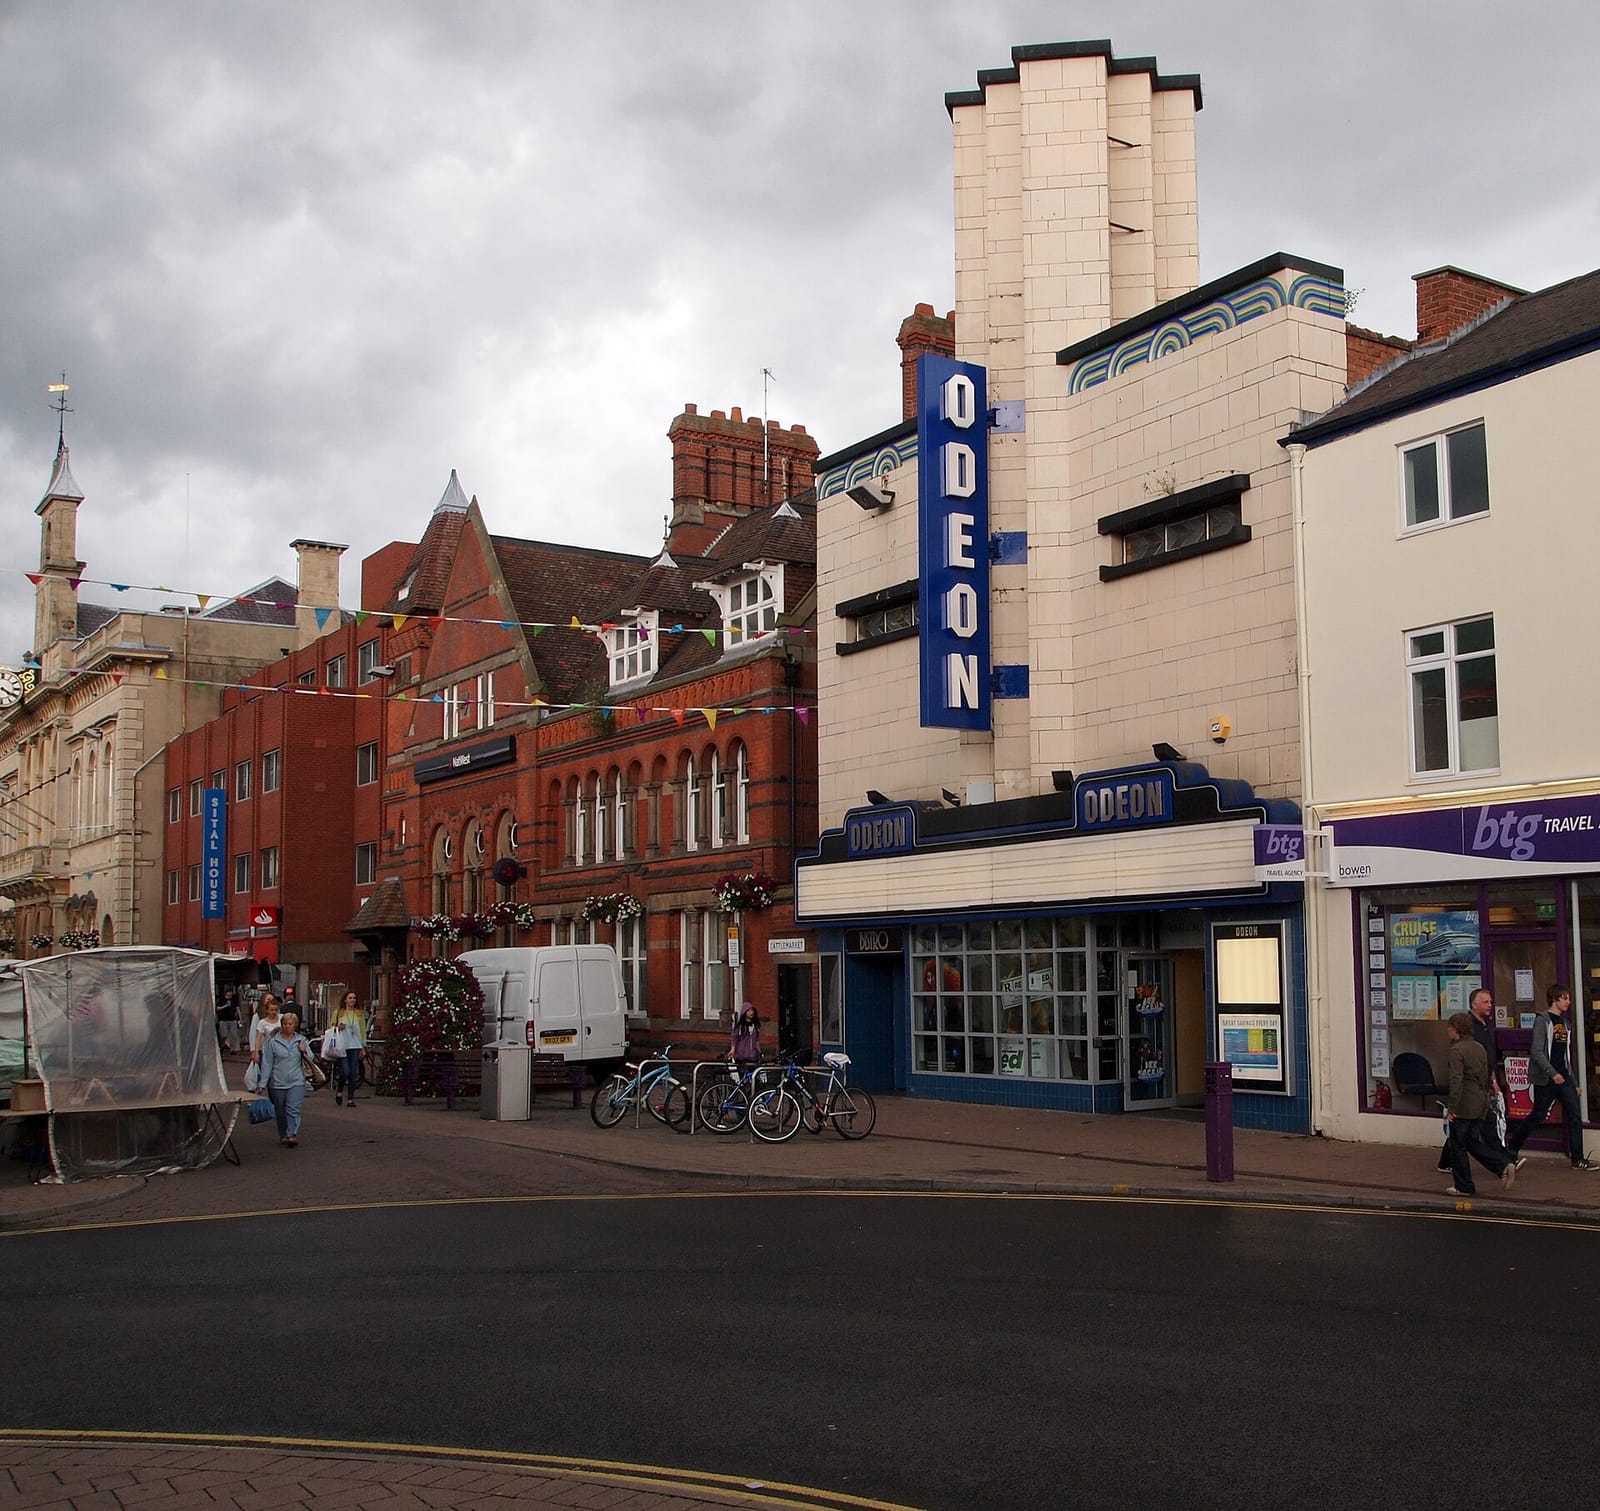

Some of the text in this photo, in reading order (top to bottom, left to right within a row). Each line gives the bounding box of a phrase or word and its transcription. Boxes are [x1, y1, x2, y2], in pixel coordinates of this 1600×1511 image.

[940, 374, 978, 709] ODEON
[1084, 780, 1163, 823] ODEON
[849, 817, 906, 851] ODEON
[1472, 805, 1595, 861] btg TRAVEL
[209, 797, 219, 910] SITAL HOUSE
[1267, 830, 1301, 861] btg
[1338, 864, 1371, 876] bowen
[1235, 926, 1258, 937] ODEON
[1393, 921, 1437, 937] CRUISE
[1394, 936, 1420, 947] AGENT
[1506, 1067, 1528, 1076] HOLIDA
[1509, 1059, 1528, 1067] THINK
